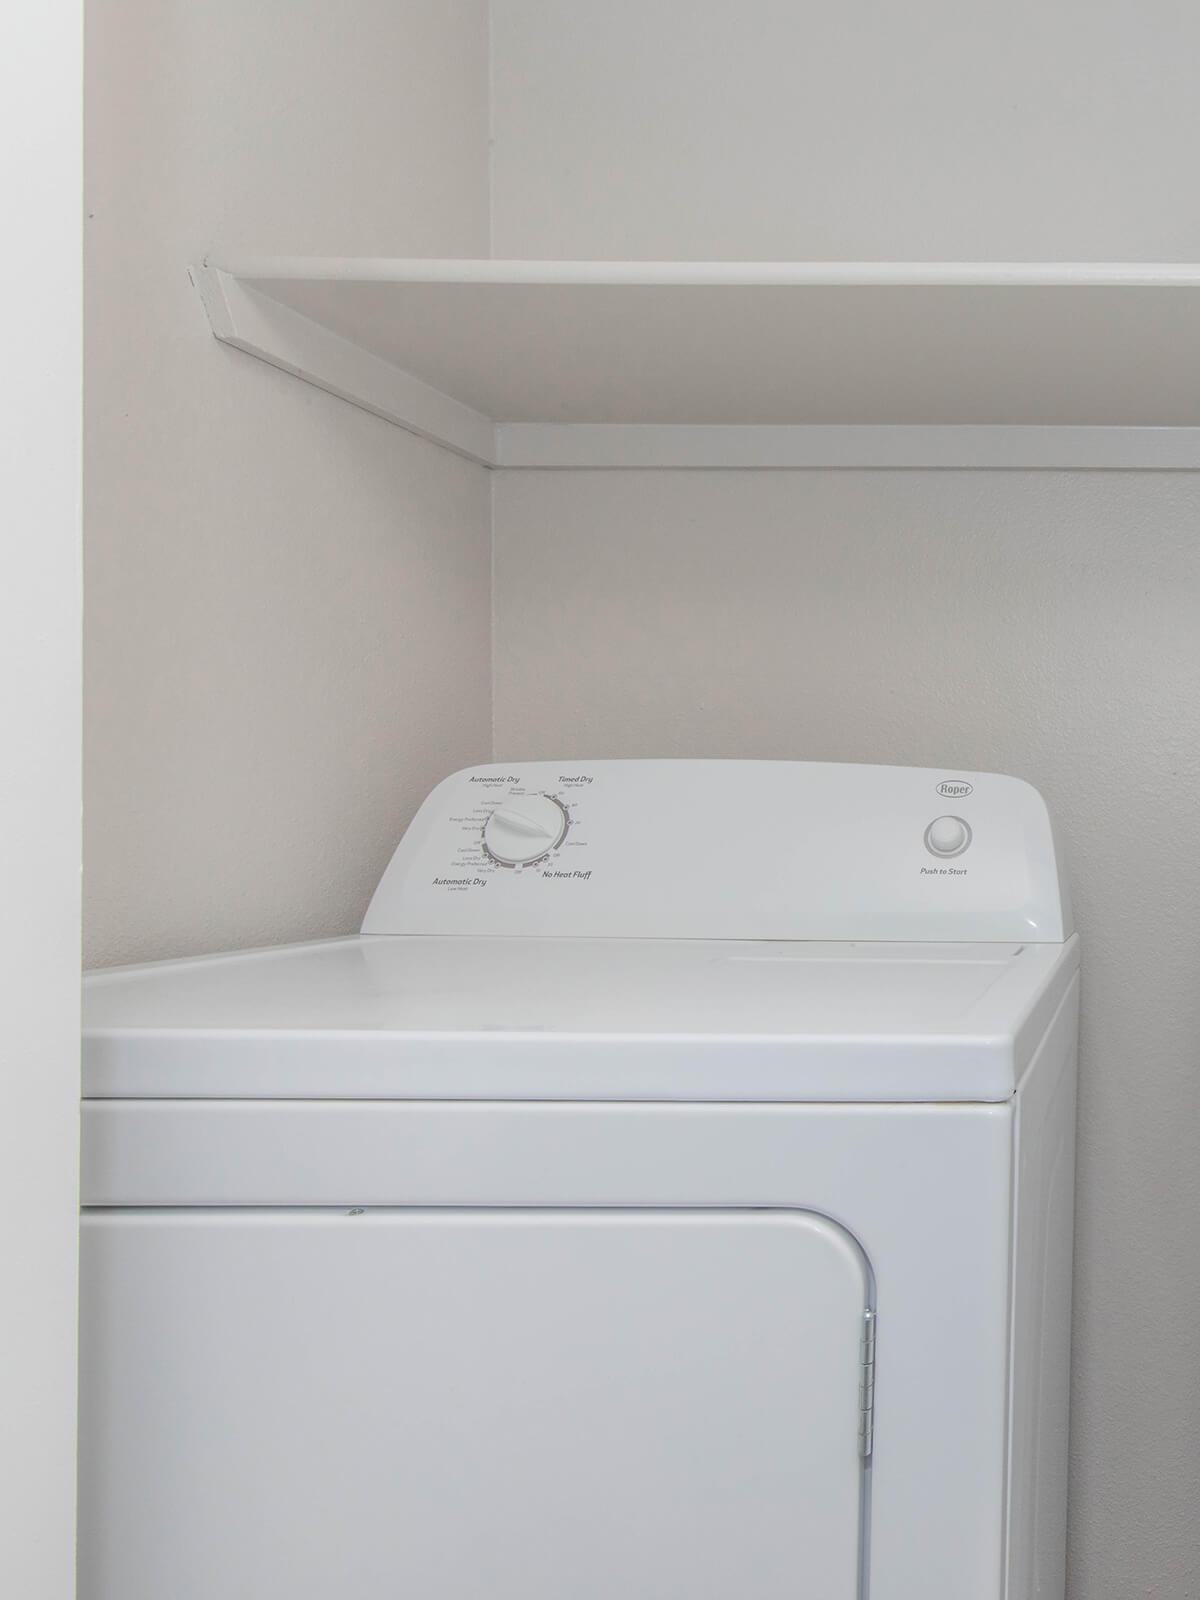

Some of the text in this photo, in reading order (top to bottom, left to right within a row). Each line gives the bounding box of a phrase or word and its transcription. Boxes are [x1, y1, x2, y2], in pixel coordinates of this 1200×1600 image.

[507, 776, 520, 784] Dry
[580, 776, 594, 784] Dry
[940, 784, 970, 795] Roper
[920, 867, 938, 875] Push
[573, 871, 592, 880] Fluff
[473, 878, 487, 887] Dry
